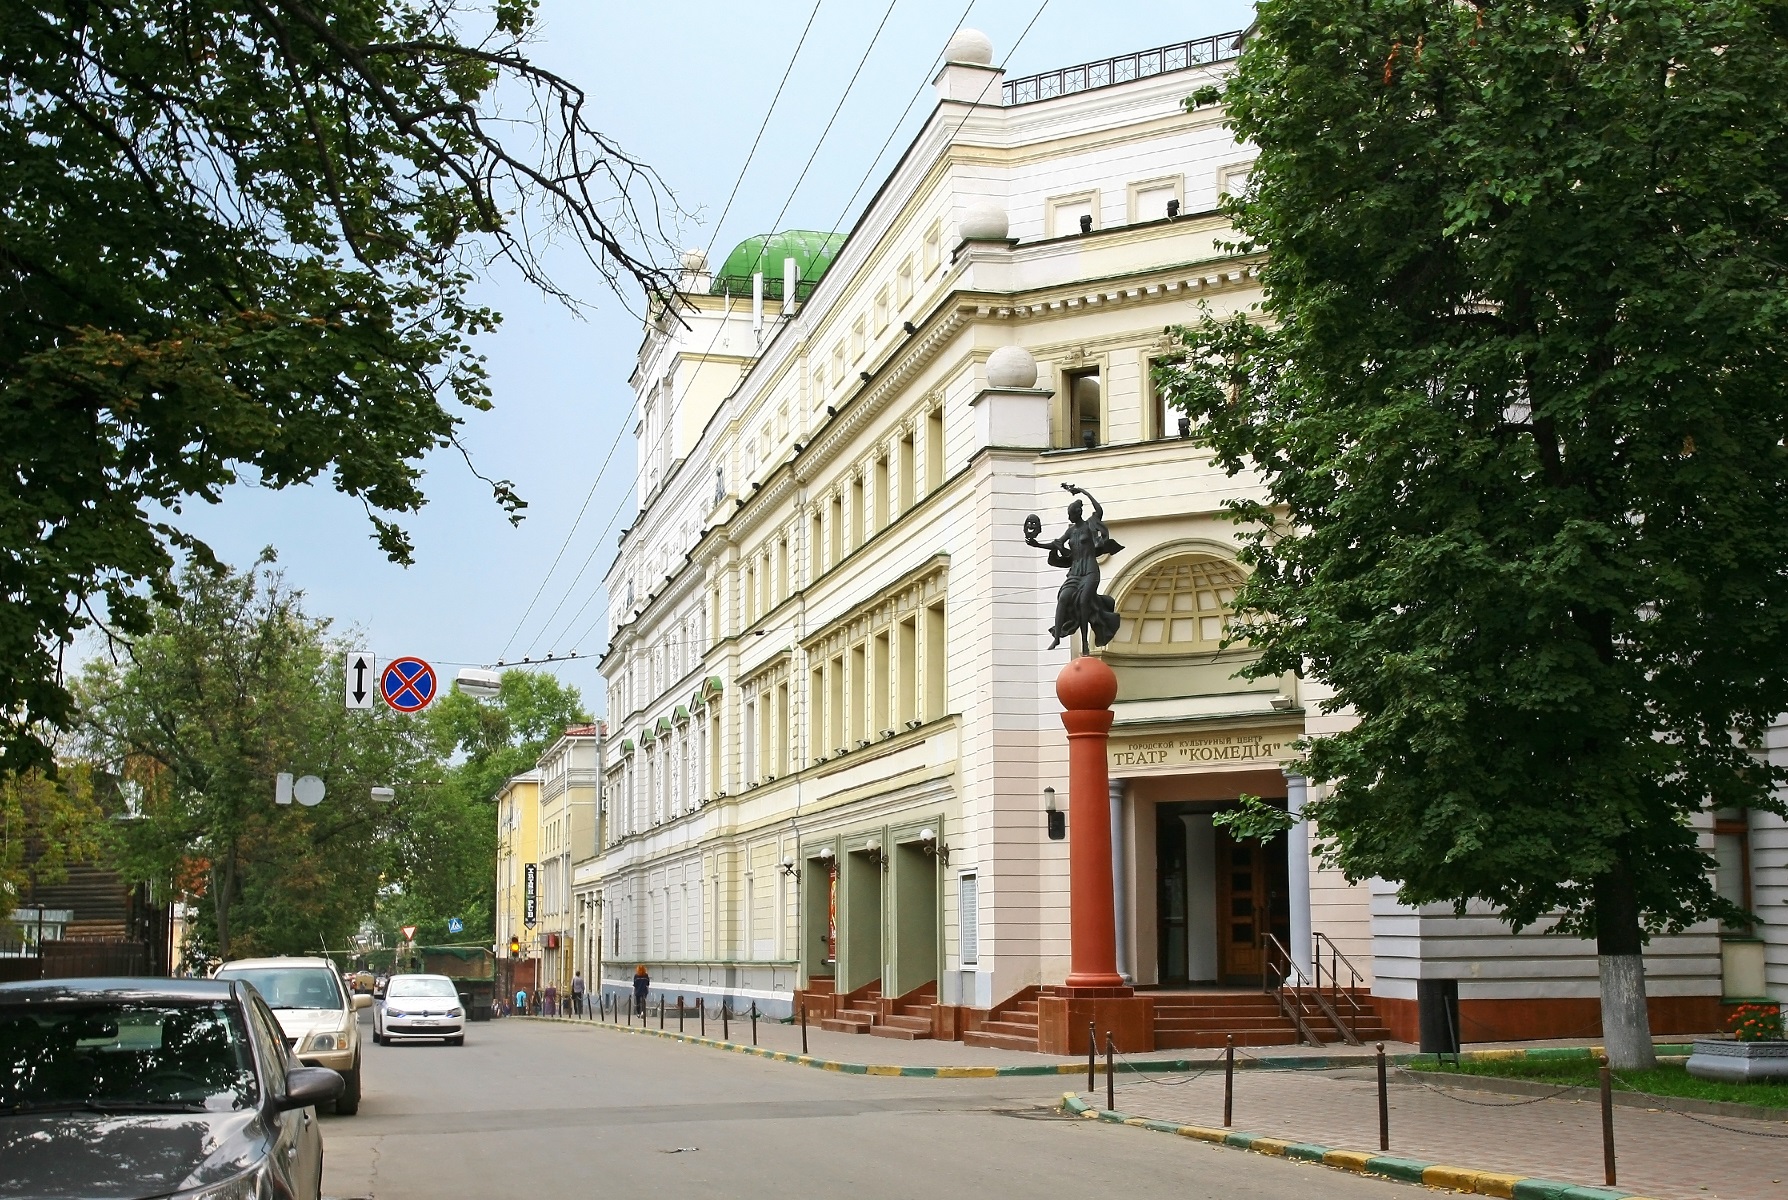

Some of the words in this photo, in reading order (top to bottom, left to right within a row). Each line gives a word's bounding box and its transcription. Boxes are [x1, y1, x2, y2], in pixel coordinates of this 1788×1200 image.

[1128, 741, 1174, 751] ГОРОДСКОЙ
[1179, 737, 1232, 747] КУЛЬТУРНЫЙ
[1236, 735, 1263, 745] ЦЕНТР
[1113, 750, 1168, 766] ТЕАТР
[527, 900, 535, 918] PUB
